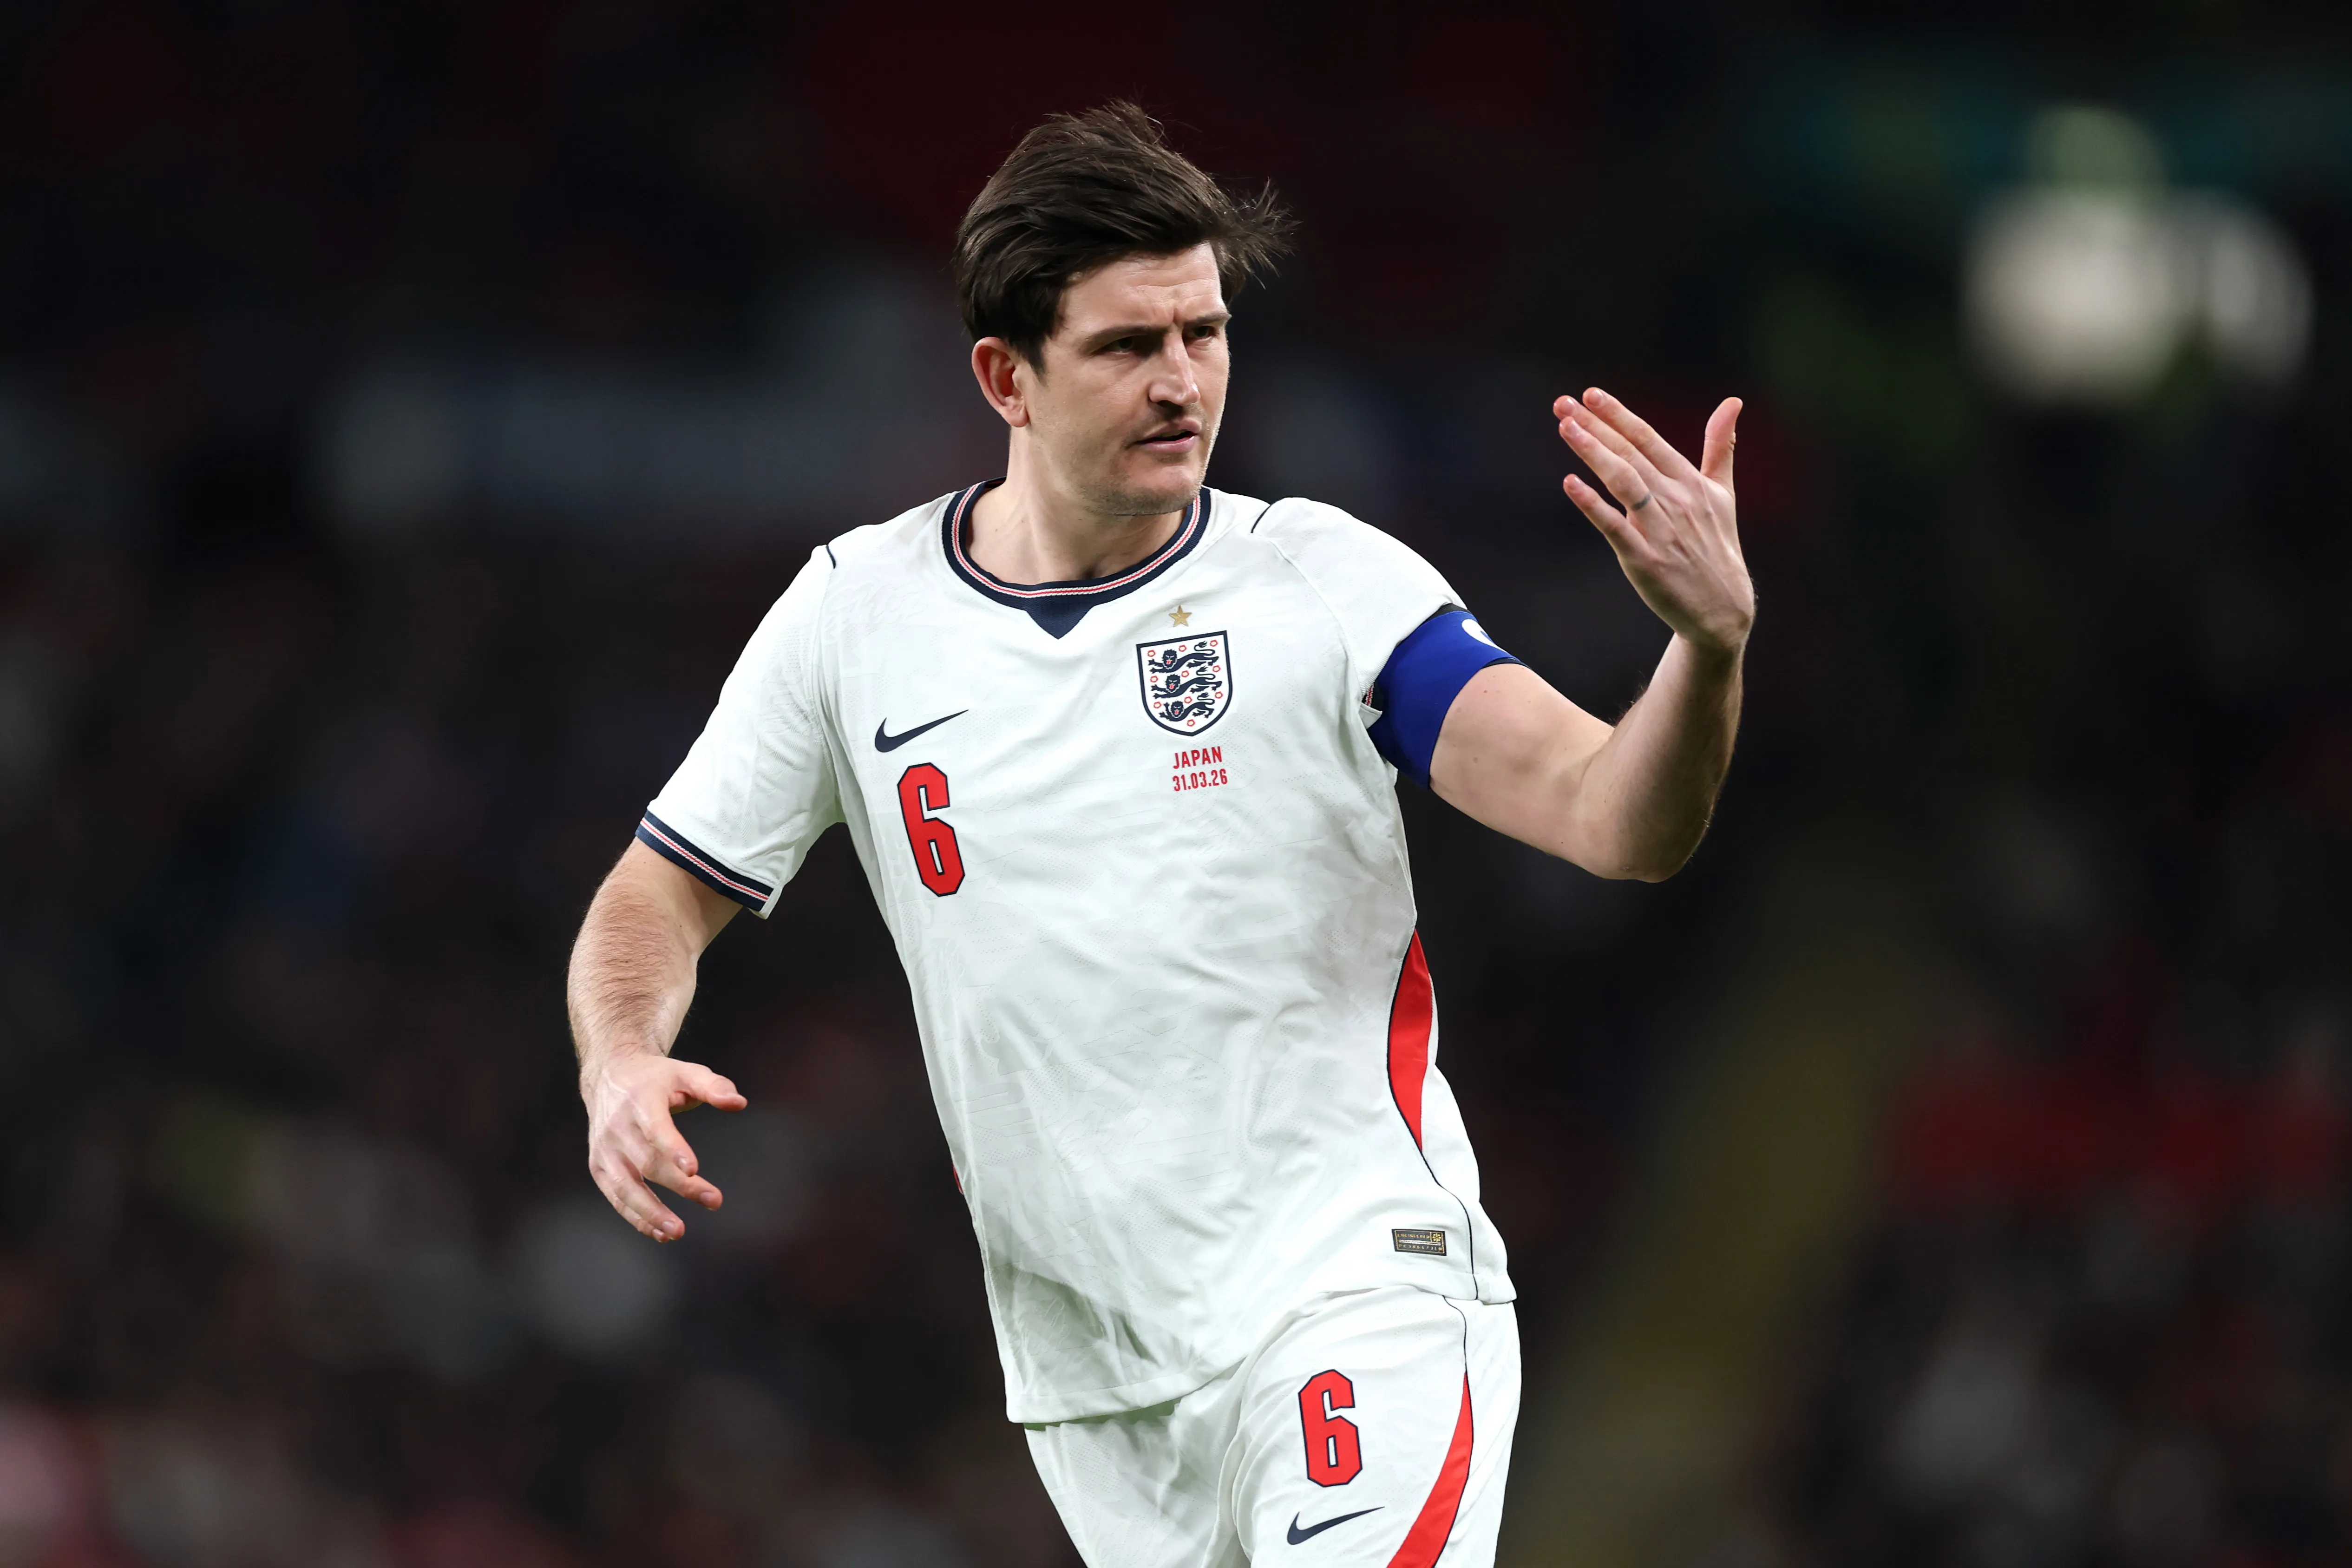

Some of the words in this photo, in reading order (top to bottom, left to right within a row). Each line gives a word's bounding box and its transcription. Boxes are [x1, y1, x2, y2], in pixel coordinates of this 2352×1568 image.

[1173, 746, 1222, 769] JAPAN
[1173, 768, 1228, 792] 31.03.26
[897, 762, 965, 898] 6
[1298, 1369, 1363, 1488] 6
